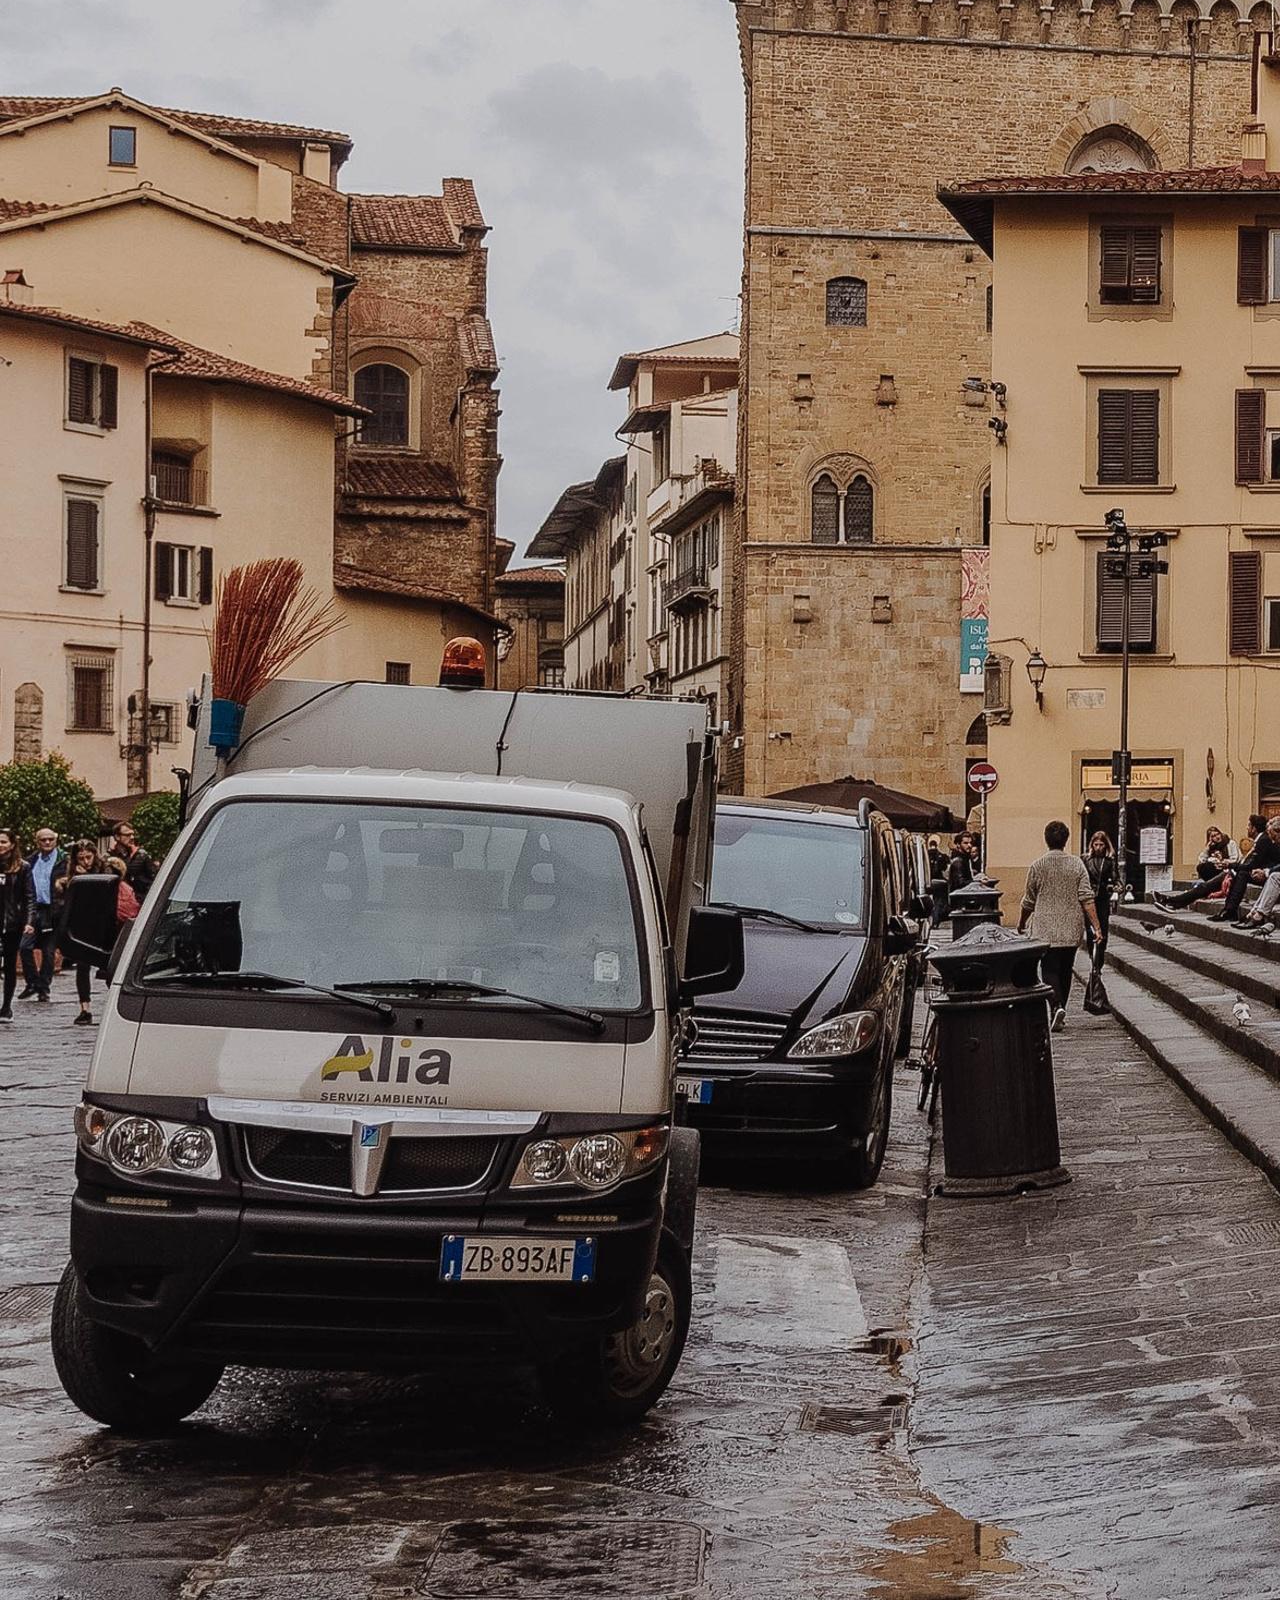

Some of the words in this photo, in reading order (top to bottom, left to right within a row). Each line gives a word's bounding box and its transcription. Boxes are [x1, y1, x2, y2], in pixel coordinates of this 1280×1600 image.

[321, 1035, 451, 1085] Alia
[321, 1092, 370, 1103] SERVIZI
[374, 1094, 448, 1105] AMBIENTALI
